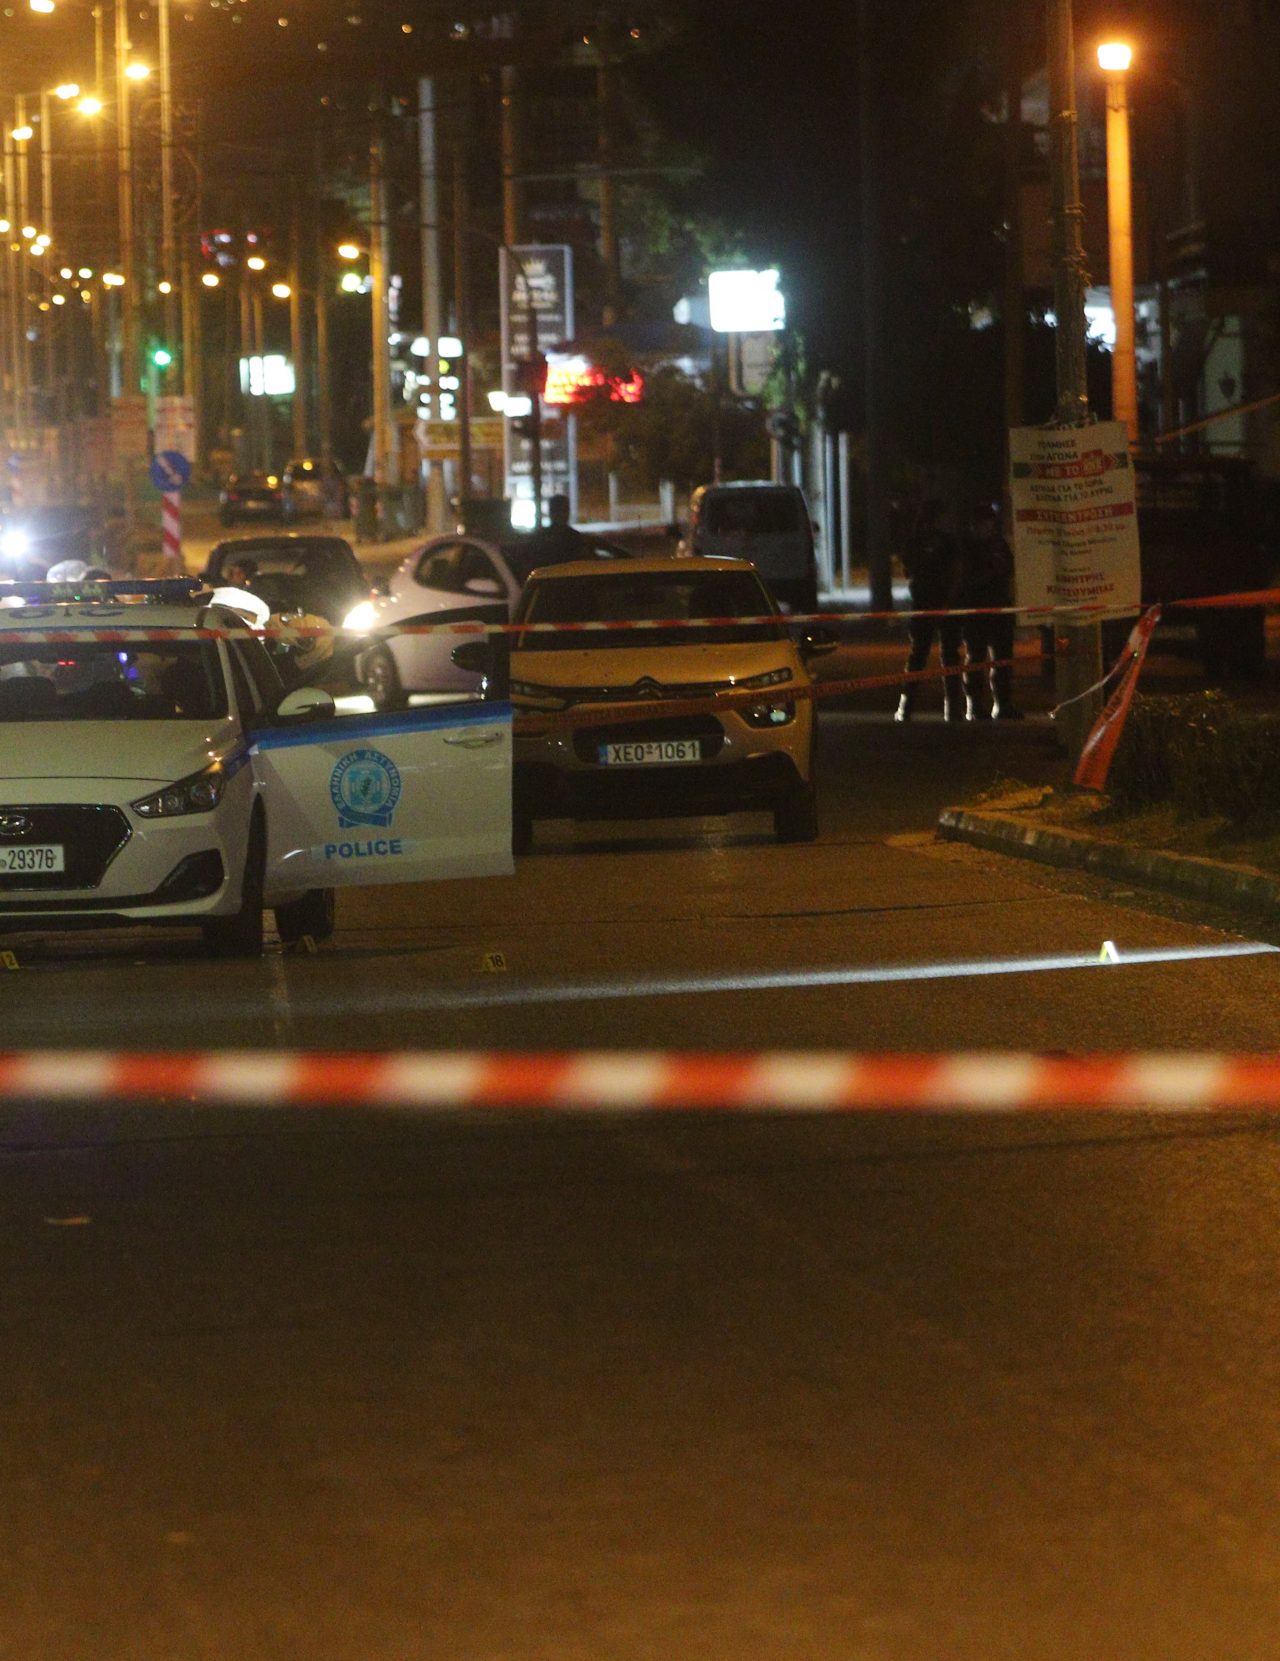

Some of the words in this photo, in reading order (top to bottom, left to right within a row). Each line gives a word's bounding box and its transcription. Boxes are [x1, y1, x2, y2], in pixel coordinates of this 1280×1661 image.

[1065, 465, 1080, 475] ΤΟ
[325, 839, 402, 859] POLICE
[488, 954, 504, 967] 18
